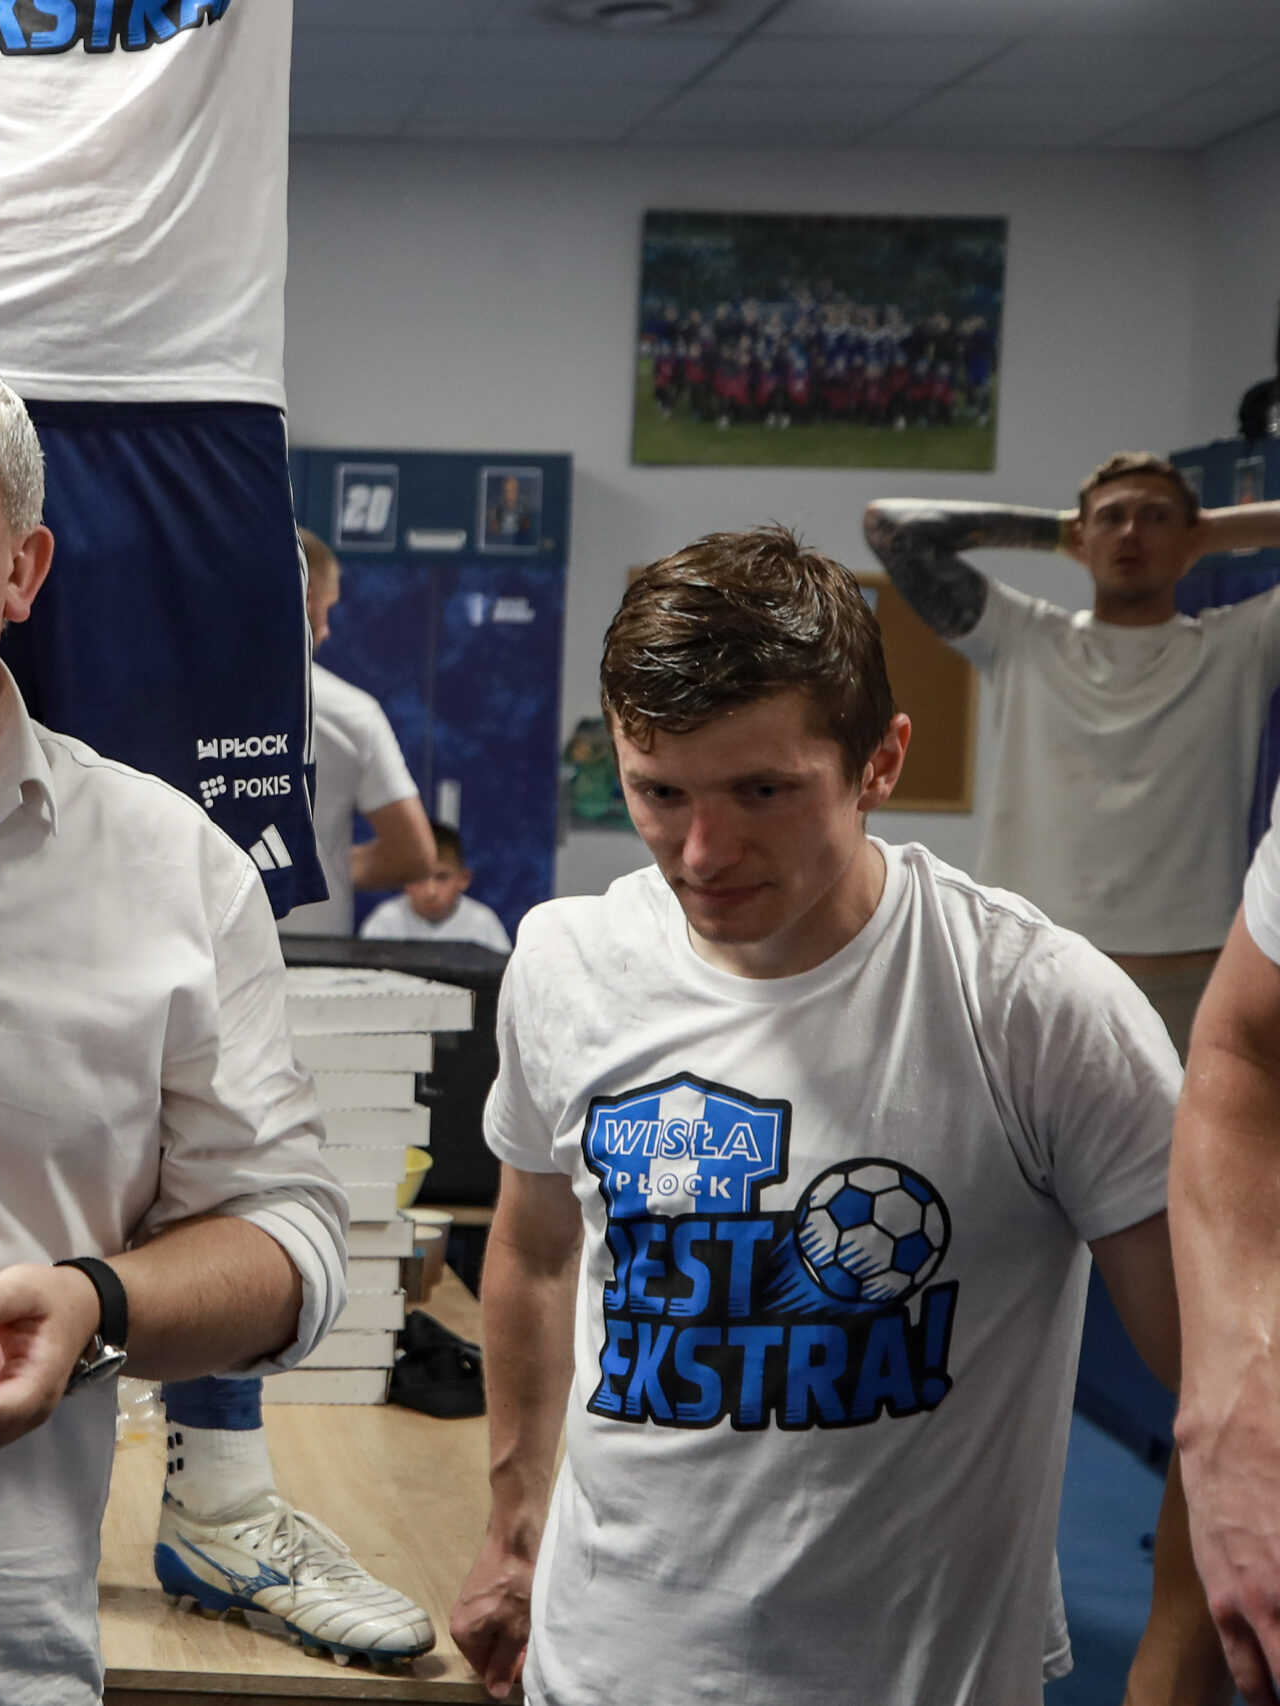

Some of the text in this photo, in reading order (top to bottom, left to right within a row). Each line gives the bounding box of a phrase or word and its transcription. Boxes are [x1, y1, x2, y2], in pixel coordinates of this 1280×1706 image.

[233, 774, 292, 799] POKIS
[604, 1118, 762, 1162] WISŁA
[615, 1171, 733, 1199] PŁOCK
[604, 1219, 774, 1319] JEST
[594, 1290, 953, 1425] EKSTRA!
